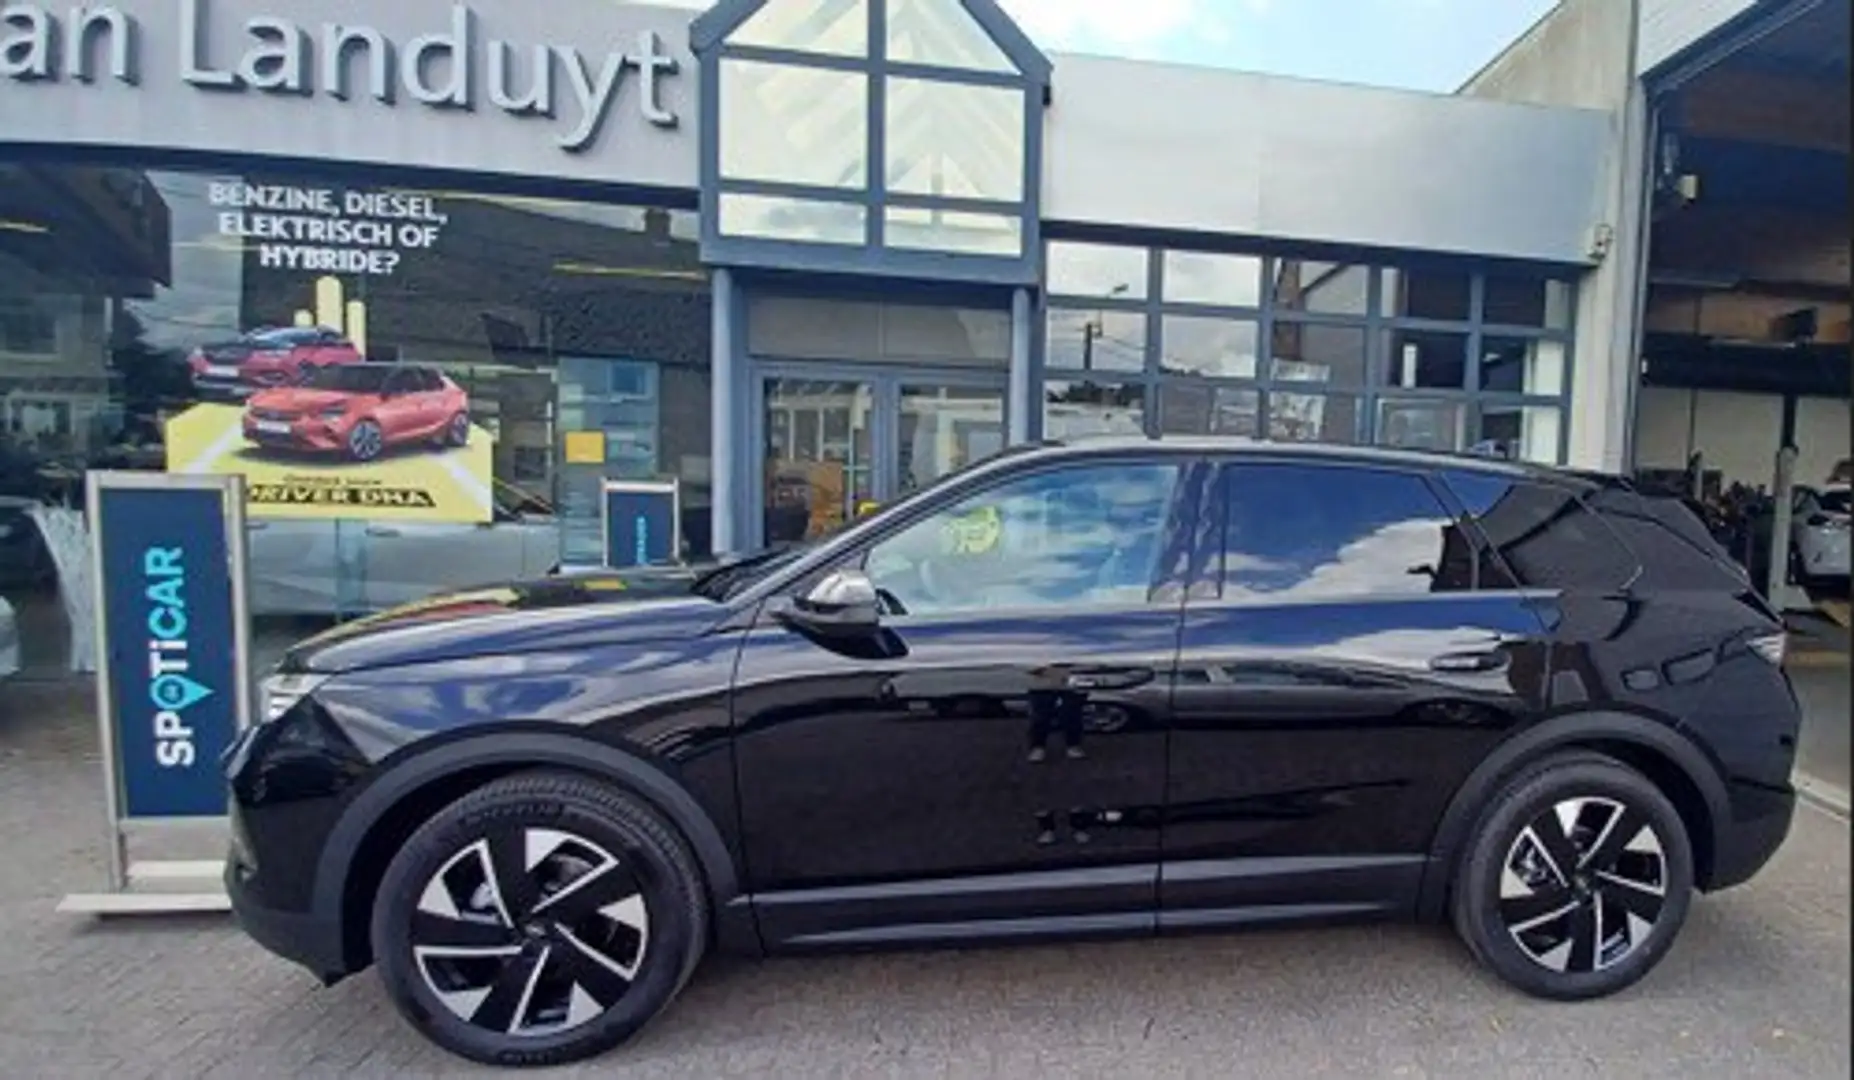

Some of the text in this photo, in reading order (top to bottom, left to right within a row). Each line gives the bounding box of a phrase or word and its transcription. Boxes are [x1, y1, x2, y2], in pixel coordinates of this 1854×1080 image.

[181, 0, 680, 152] Landuyt
[208, 182, 448, 225] BENZINE, DIESEL,
[218, 211, 439, 248] ELEKTRISCH OF
[259, 244, 400, 275] HYBRIDE?
